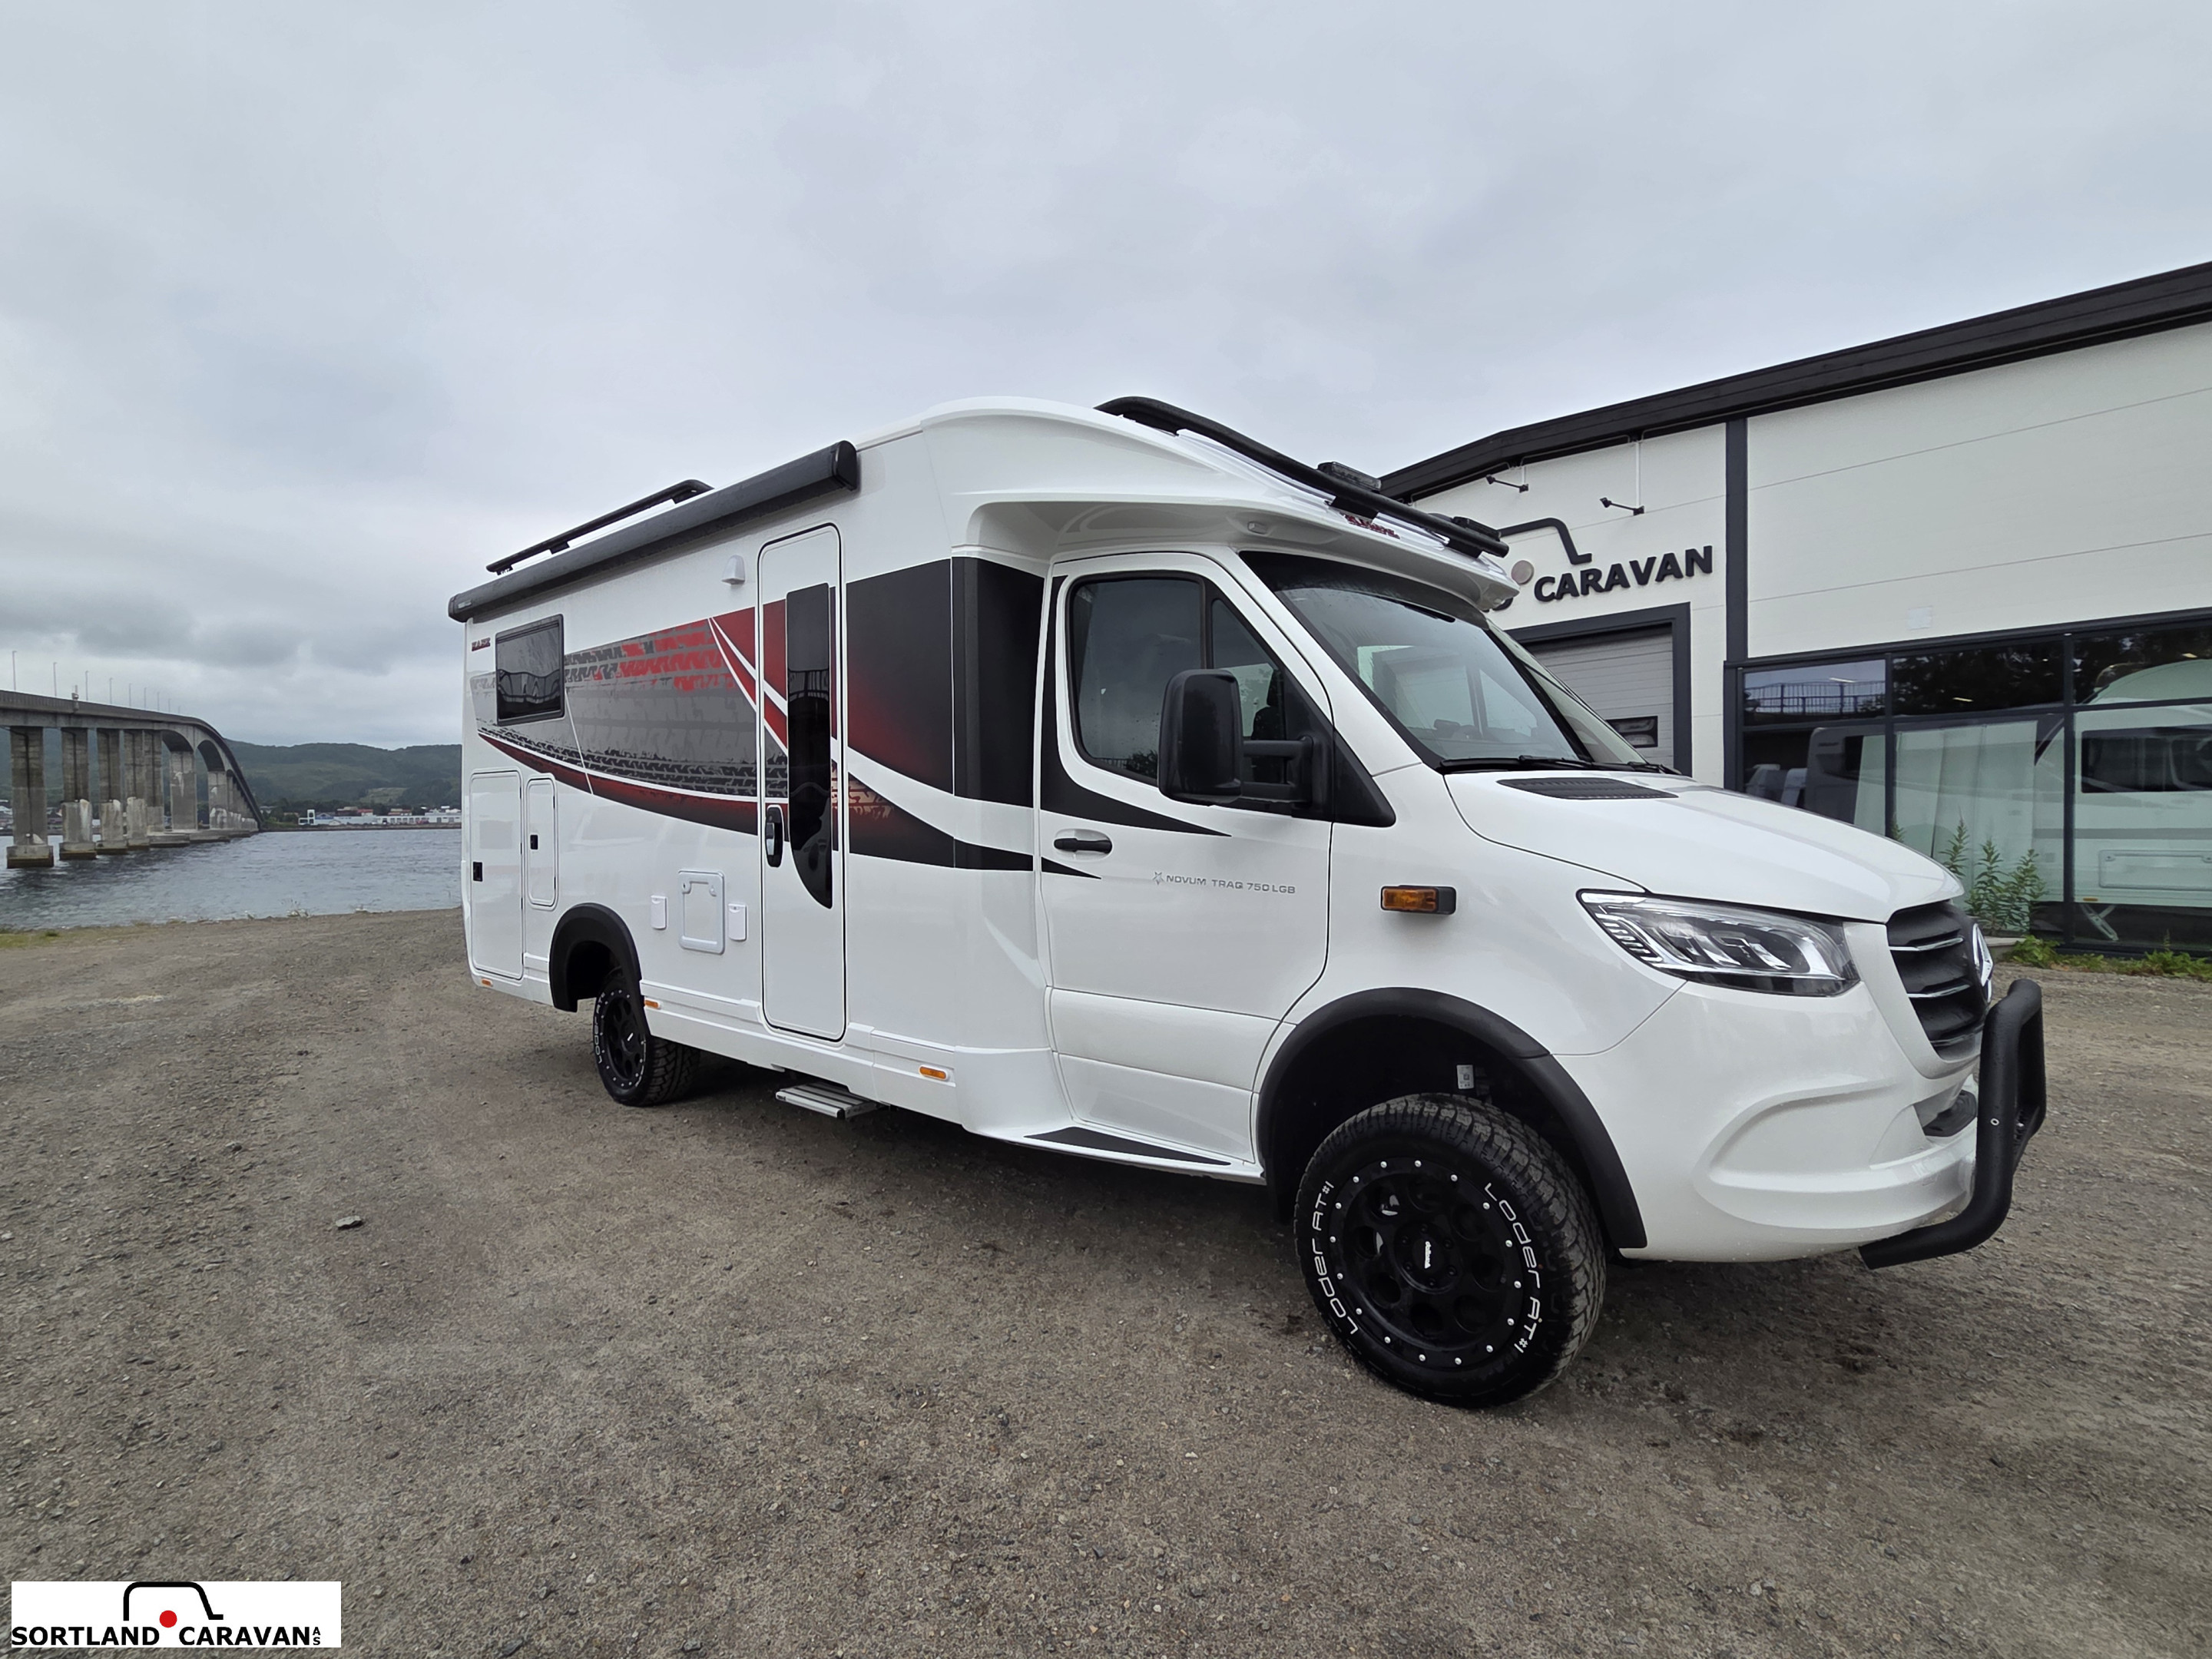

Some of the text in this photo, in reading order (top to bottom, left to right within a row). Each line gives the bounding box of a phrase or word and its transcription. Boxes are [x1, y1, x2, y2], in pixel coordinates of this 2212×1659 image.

[1534, 545, 1713, 602] CARAVAN
[1166, 875, 1207, 886] NOVUM
[1247, 882, 1270, 892] 750
[1272, 884, 1296, 894] LGB
